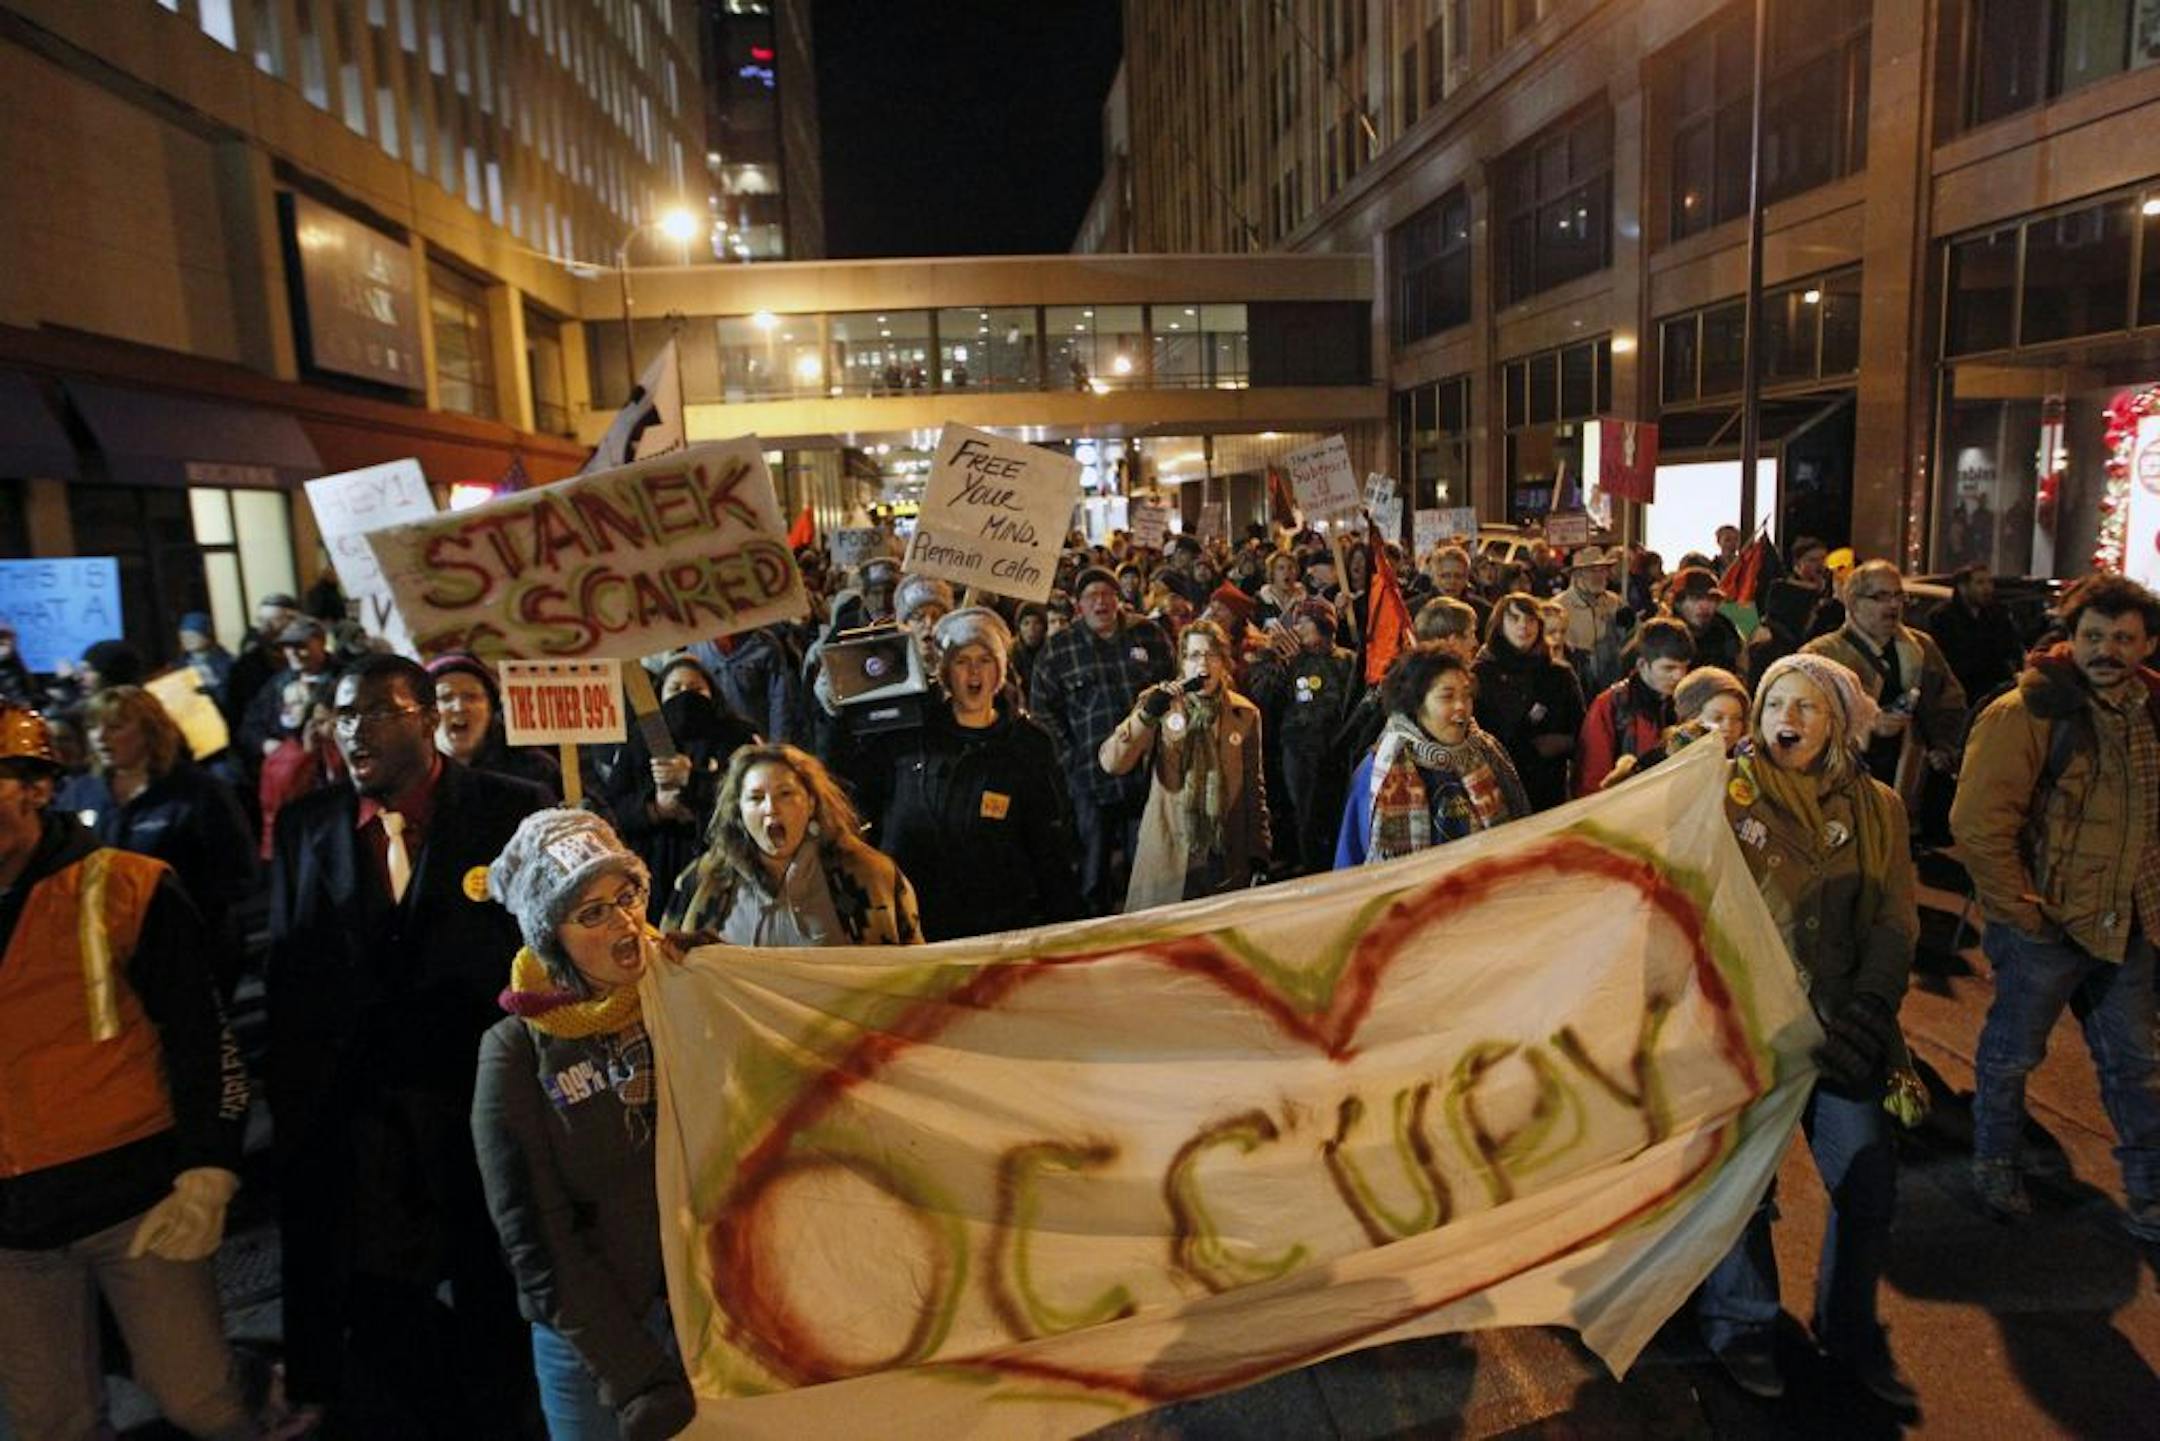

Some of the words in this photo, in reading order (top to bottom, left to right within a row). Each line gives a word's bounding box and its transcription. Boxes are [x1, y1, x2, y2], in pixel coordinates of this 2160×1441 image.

[948, 438, 1028, 480] FREE
[422, 453, 762, 610] STANEK
[837, 529, 882, 547] FOOD
[979, 513, 1040, 548] MIND.
[911, 530, 983, 569] Remain
[990, 556, 1041, 587] calm
[505, 540, 794, 656] SCARED
[508, 685, 536, 730] THE
[536, 685, 583, 730] OTHER
[583, 683, 617, 730] 99%
[706, 992, 1680, 1386] OCCUPY
